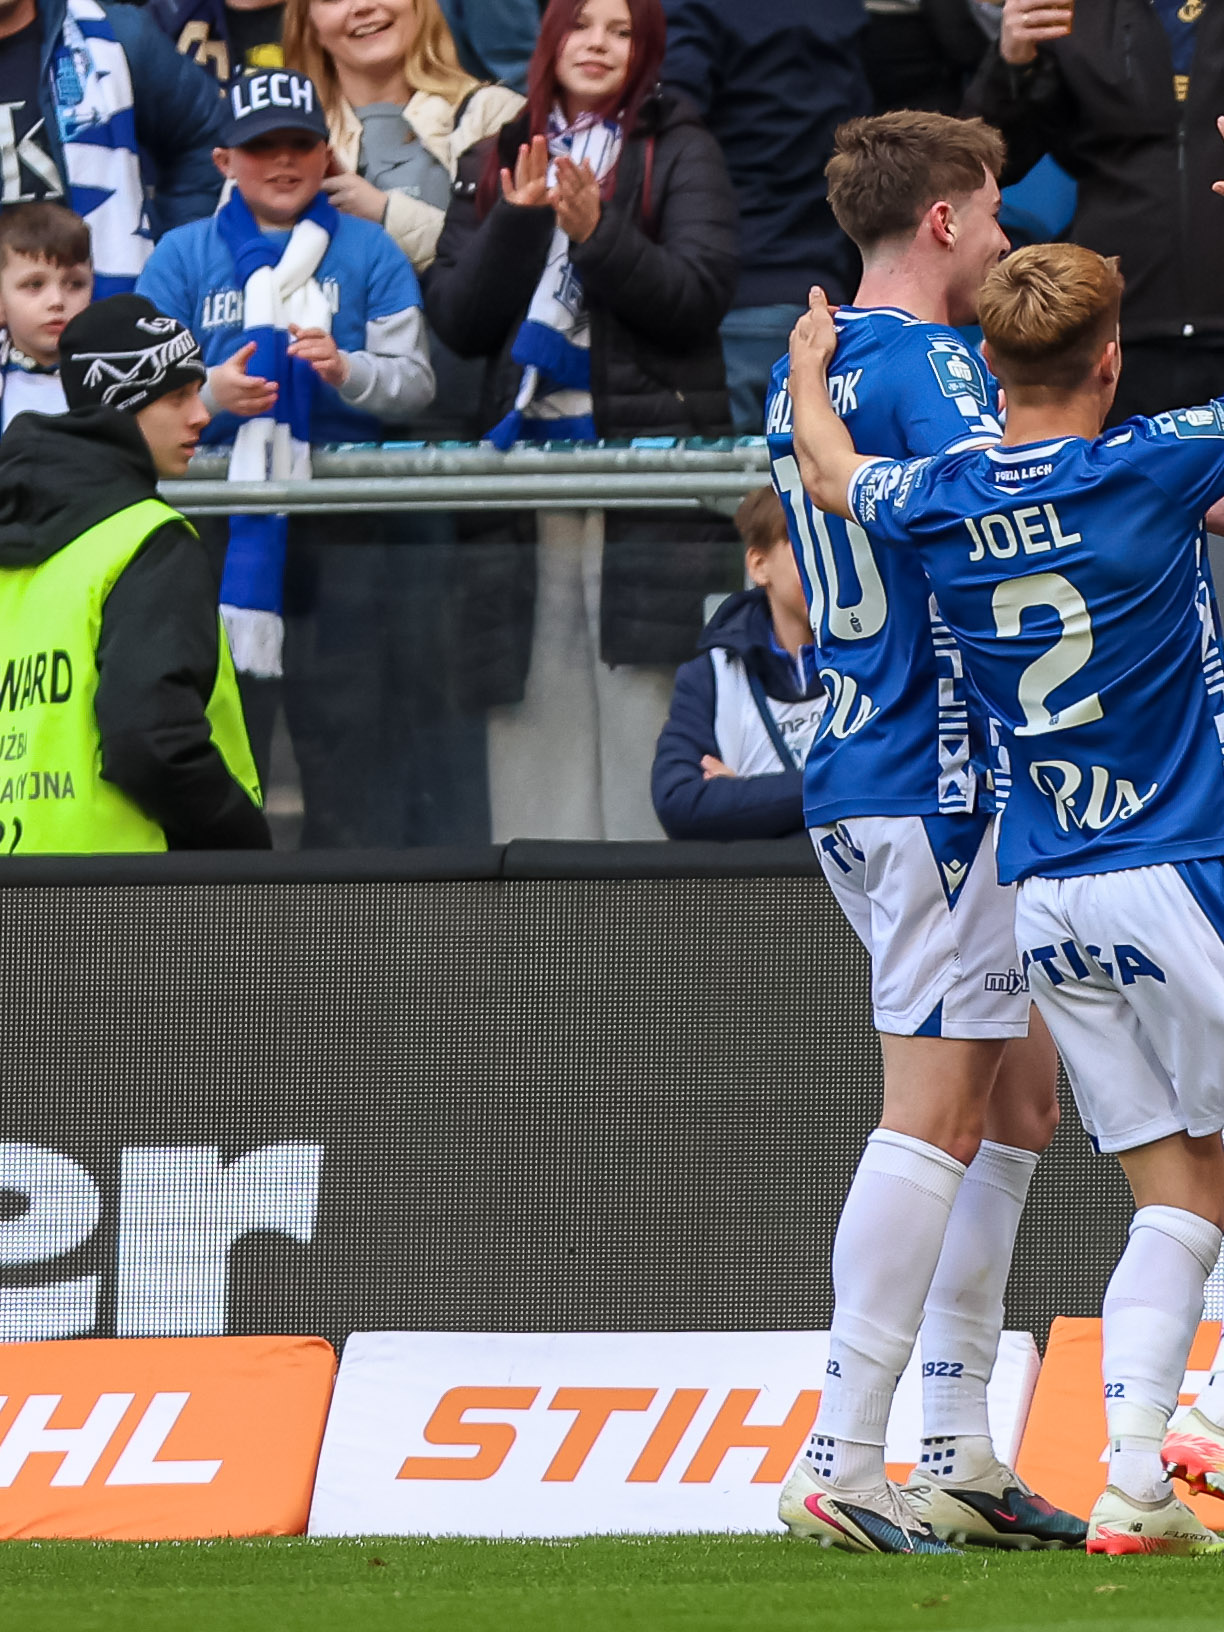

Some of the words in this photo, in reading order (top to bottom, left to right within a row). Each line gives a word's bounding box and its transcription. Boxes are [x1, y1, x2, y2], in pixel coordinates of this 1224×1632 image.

[231, 72, 313, 121] LECH
[1021, 463, 1054, 480] LECH
[772, 454, 888, 649] 10
[964, 503, 1082, 562] JOEL
[991, 572, 1105, 737] 2
[0, 1392, 223, 1488] HL
[395, 1385, 917, 1485] STIH
